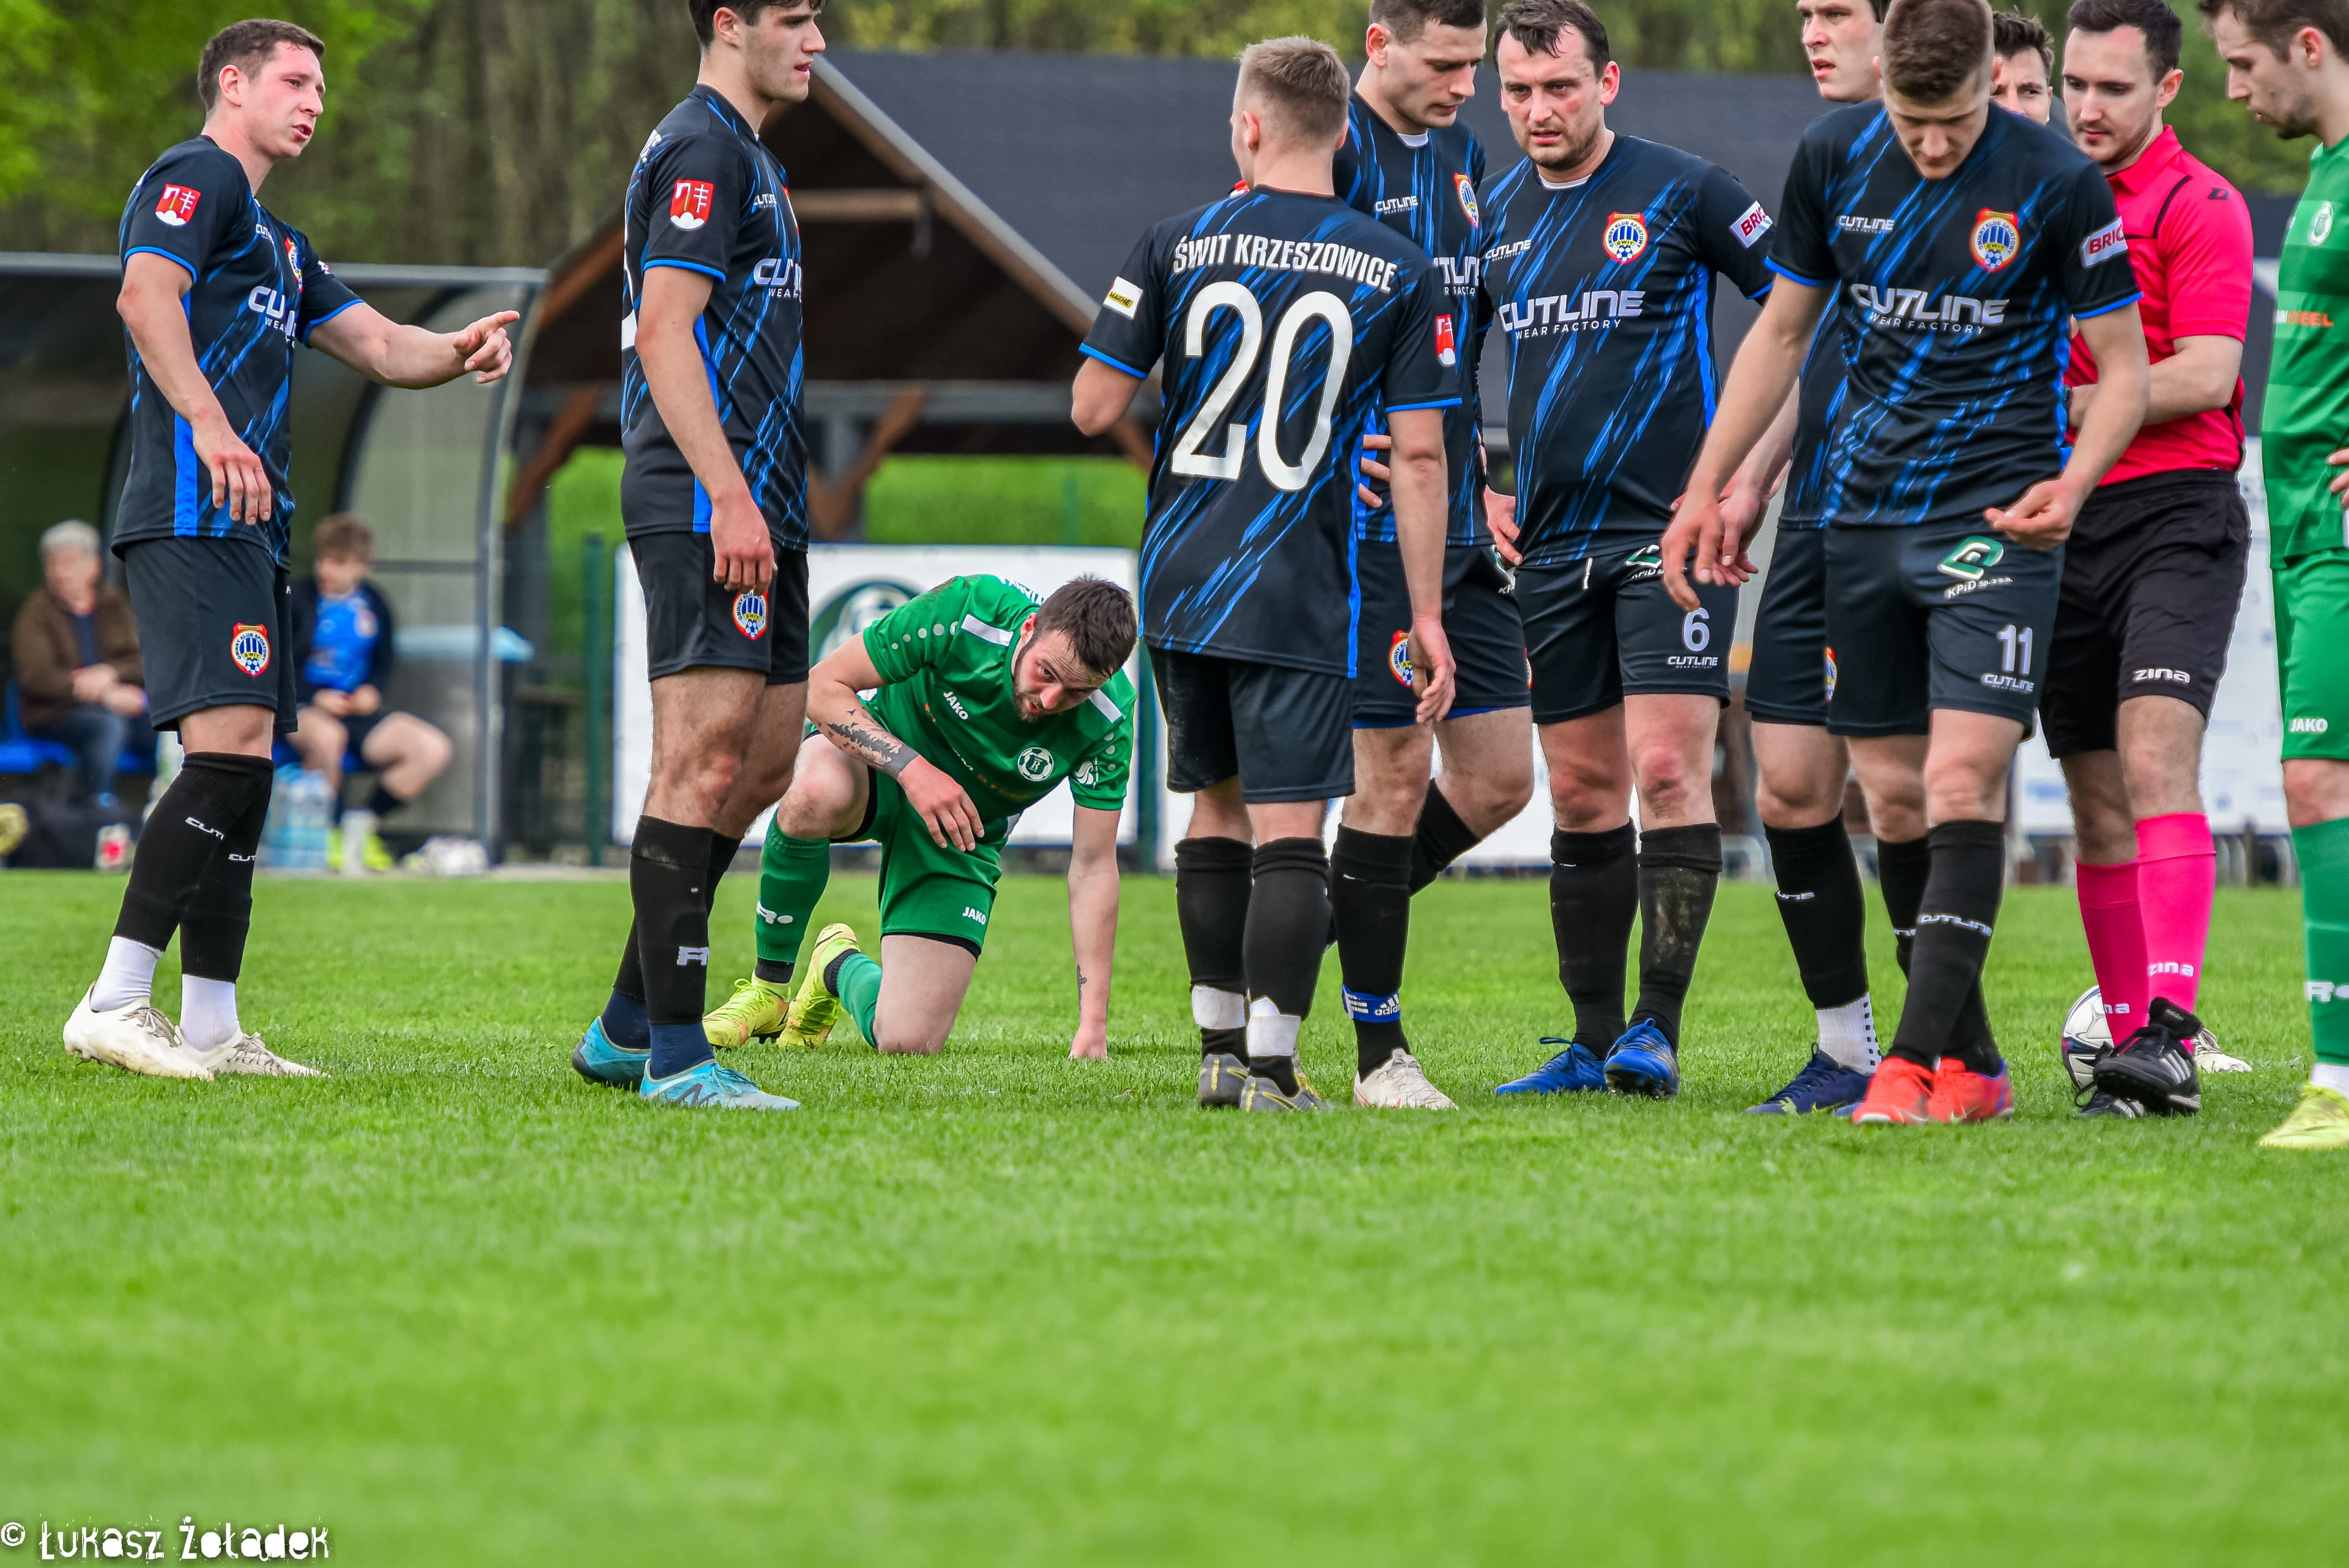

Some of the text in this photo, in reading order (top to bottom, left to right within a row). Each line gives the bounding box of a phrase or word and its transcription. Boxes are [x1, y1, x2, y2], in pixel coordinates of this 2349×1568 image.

[1375, 196, 1419, 212] CUTLINE
[1839, 215, 1894, 231] CUTLINE
[1485, 239, 1532, 259] CUTLINE
[2002, 223, 2016, 255] SPORTOWY
[1173, 234, 1398, 293] ŚWIT KRZESZOWICE
[1499, 290, 1646, 332] CUTLINE
[1850, 284, 2010, 325] CUTLINE
[1515, 319, 1621, 340] WEAR FACTORY
[1869, 311, 1984, 334] WEAR FACTORY
[1171, 281, 1353, 491] 20
[1684, 607, 1710, 652] 6
[254, 634, 267, 661] SPORTOWY
[1998, 625, 2033, 675] 11
[1668, 656, 1718, 666] CUTLINE
[1984, 674, 2035, 692] CUTLINE
[2135, 669, 2191, 683] zina
[943, 691, 968, 720] JAKO
[2290, 718, 2328, 732] JAKO
[962, 906, 986, 925] JAKO
[1920, 915, 1992, 936] CUTLINE
[2149, 962, 2194, 977] zina
